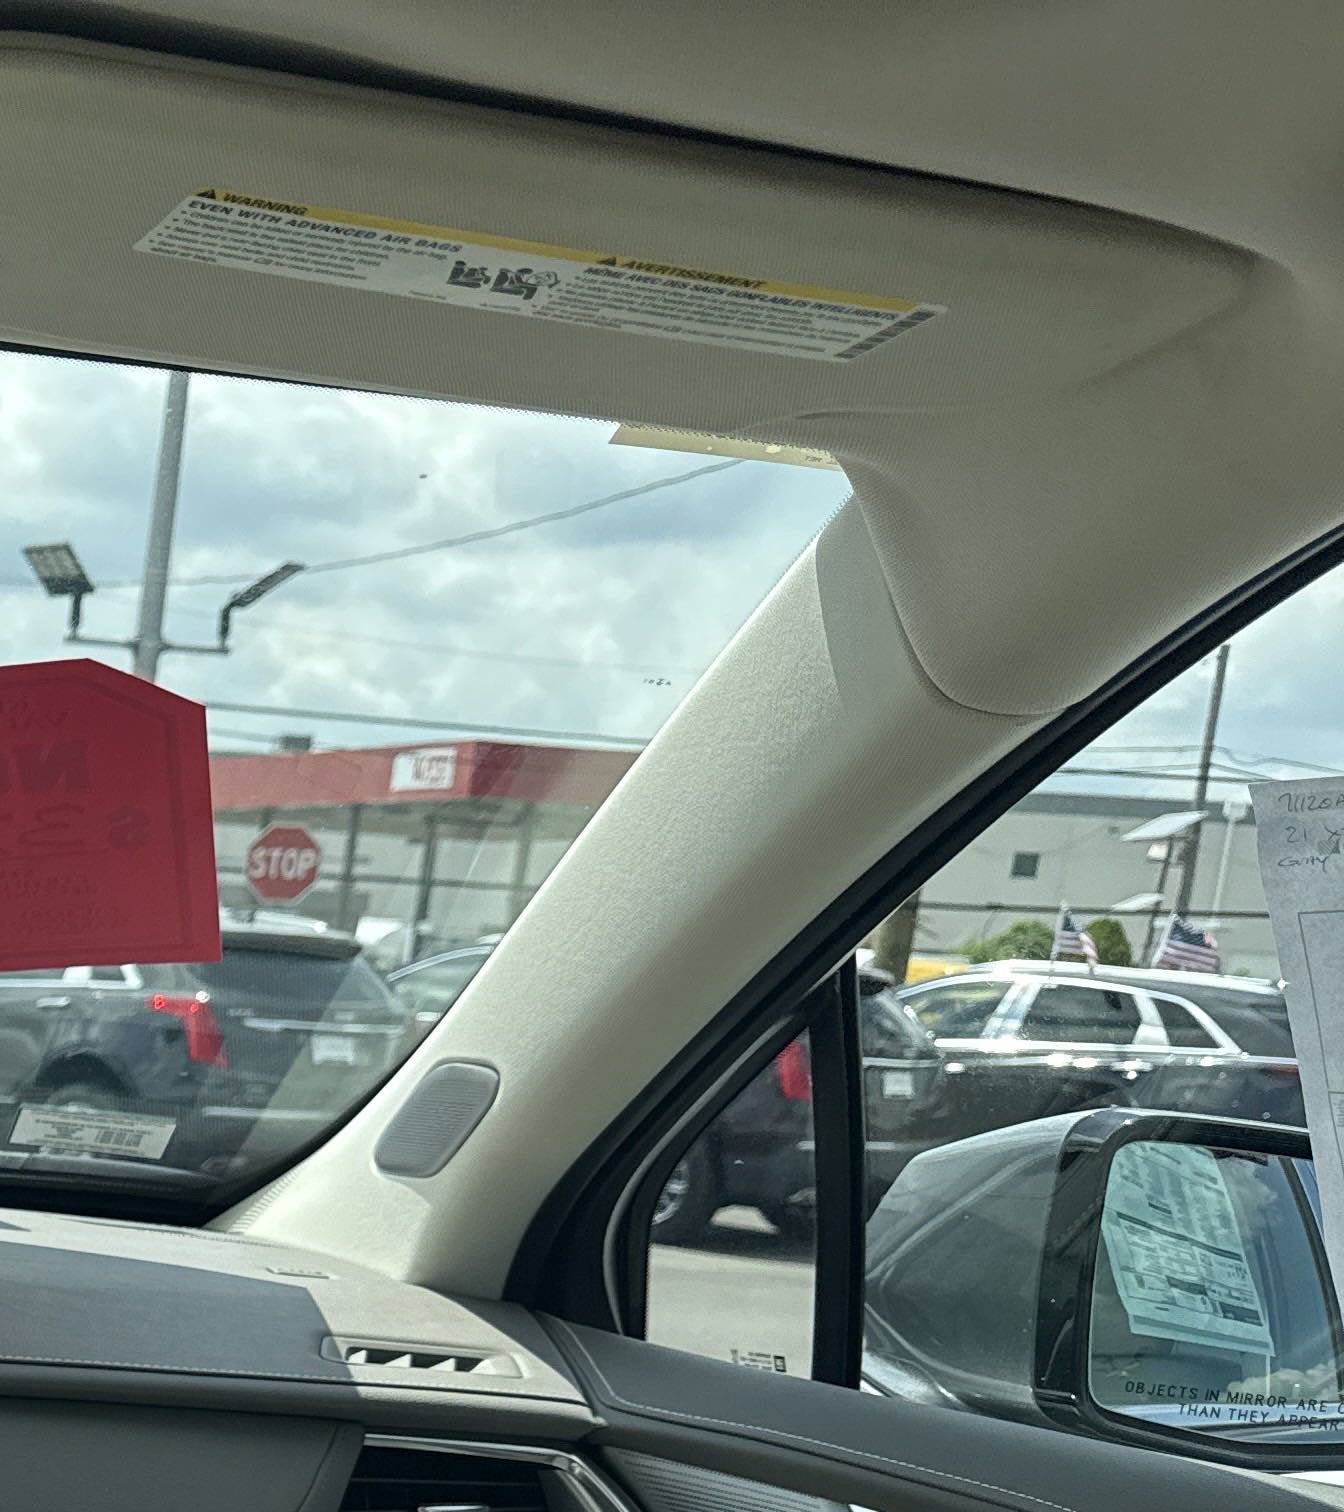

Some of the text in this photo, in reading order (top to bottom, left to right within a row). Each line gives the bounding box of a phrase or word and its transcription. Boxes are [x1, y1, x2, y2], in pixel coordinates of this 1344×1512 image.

[223, 193, 307, 216] WARNING
[189, 200, 462, 252] EVEN WITH ADVANCED AIR BAGS
[622, 260, 766, 289] AVERTISSEMENT
[626, 274, 663, 285] AVEC
[662, 280, 690, 289] DES
[1285, 826, 1307, 843] 21
[249, 847, 317, 880] STOP
[1125, 1380, 1200, 1399] OBJECTS
[1205, 1390, 1220, 1401] IN
[1227, 1391, 1288, 1408] MIRROR
[1296, 1399, 1329, 1413] ARE
[1178, 1403, 1340, 1431] THAN THEY APPEAR
